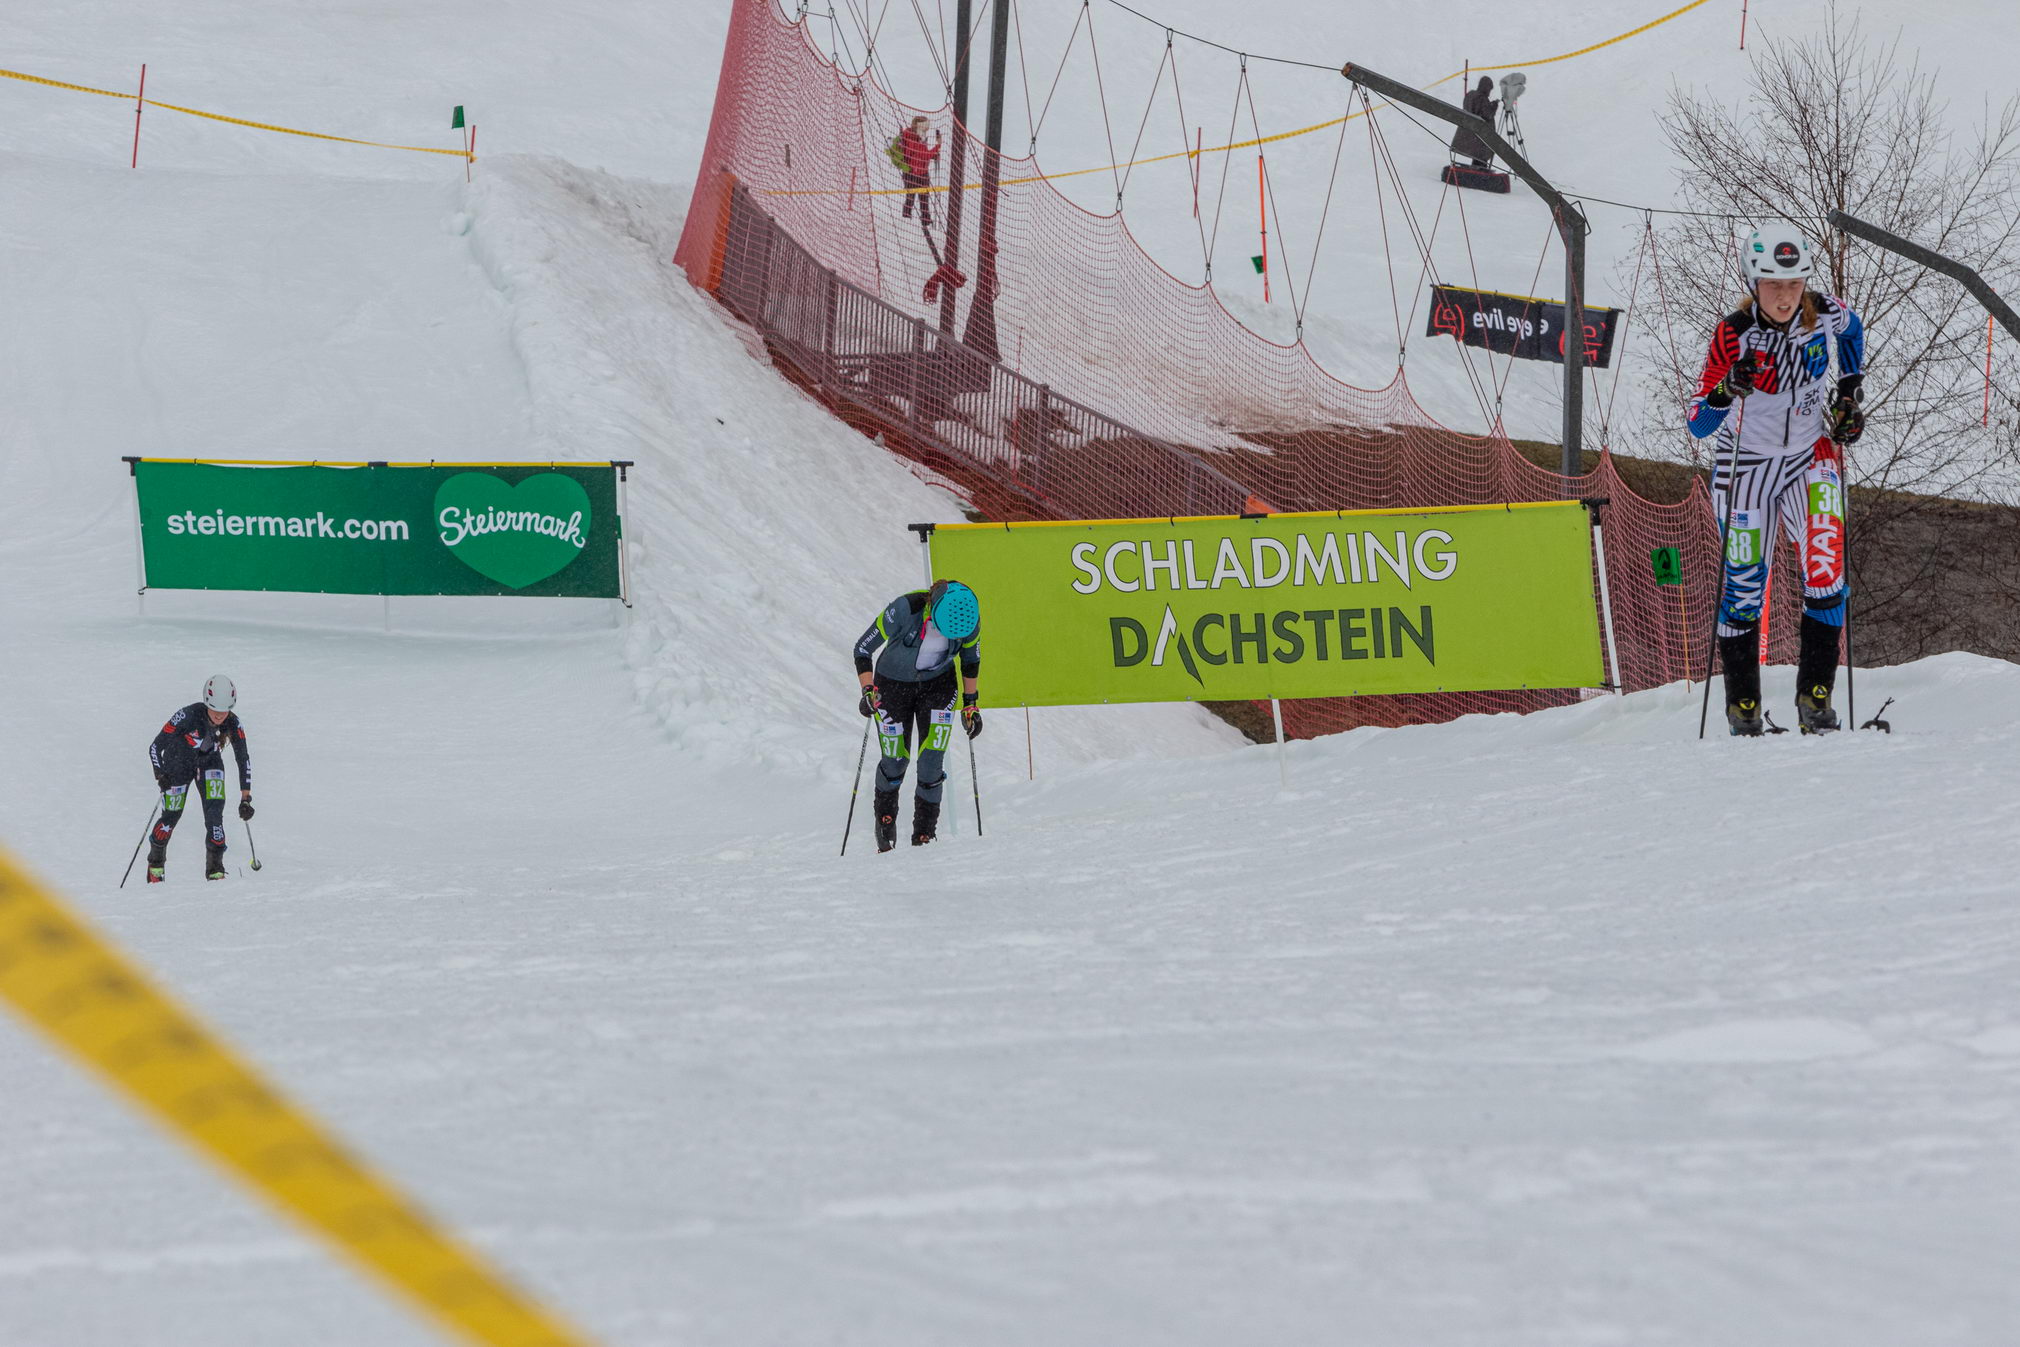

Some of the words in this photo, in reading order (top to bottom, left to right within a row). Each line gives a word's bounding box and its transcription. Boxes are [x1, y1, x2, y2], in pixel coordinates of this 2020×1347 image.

[1473, 308, 1505, 330] evil
[1818, 483, 1842, 517] 38
[167, 508, 409, 540] steiermark.com
[439, 505, 586, 548] Steiermark
[1070, 528, 1459, 594] SCHLADMING
[1728, 528, 1752, 563] 38
[1109, 602, 1435, 688] DACHSTEIN
[882, 736, 899, 757] 37
[933, 725, 950, 749] 37
[169, 795, 182, 810] 32
[210, 780, 223, 798] 32
